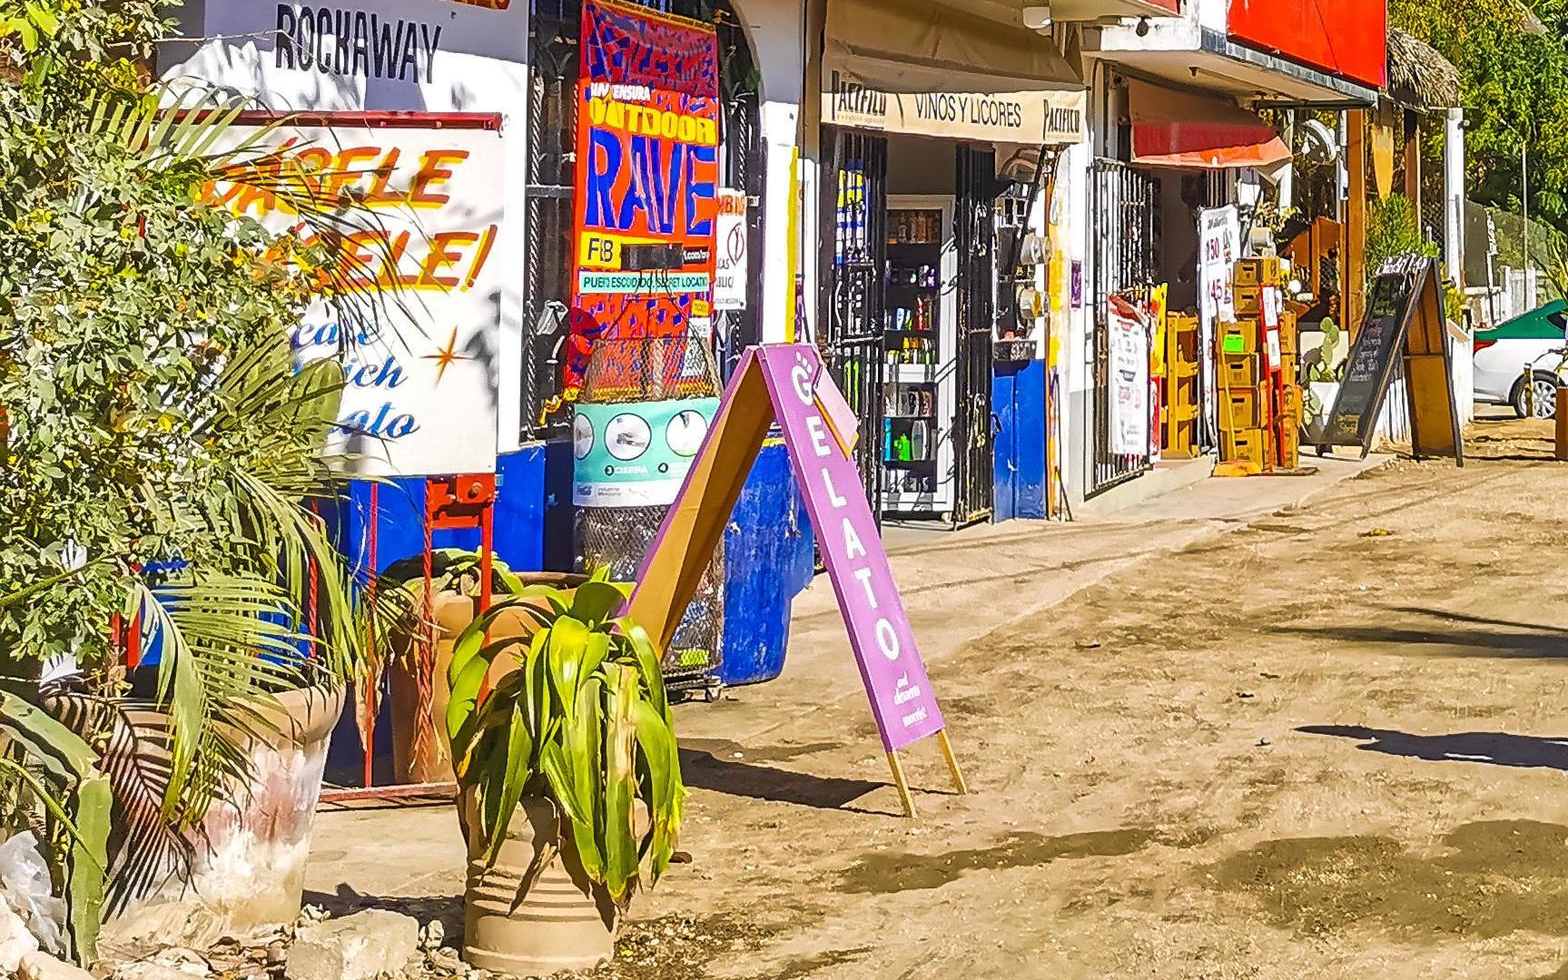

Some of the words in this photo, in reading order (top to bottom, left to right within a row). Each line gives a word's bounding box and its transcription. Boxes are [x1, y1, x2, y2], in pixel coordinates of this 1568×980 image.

[275, 3, 442, 85] ROCKAWAY
[914, 92, 956, 121] VINOS
[958, 96, 968, 121] Y
[970, 99, 1022, 128] LICORES
[1043, 99, 1080, 141] PACIFICO
[585, 126, 717, 236] RAVE
[791, 355, 901, 662] GELATO
